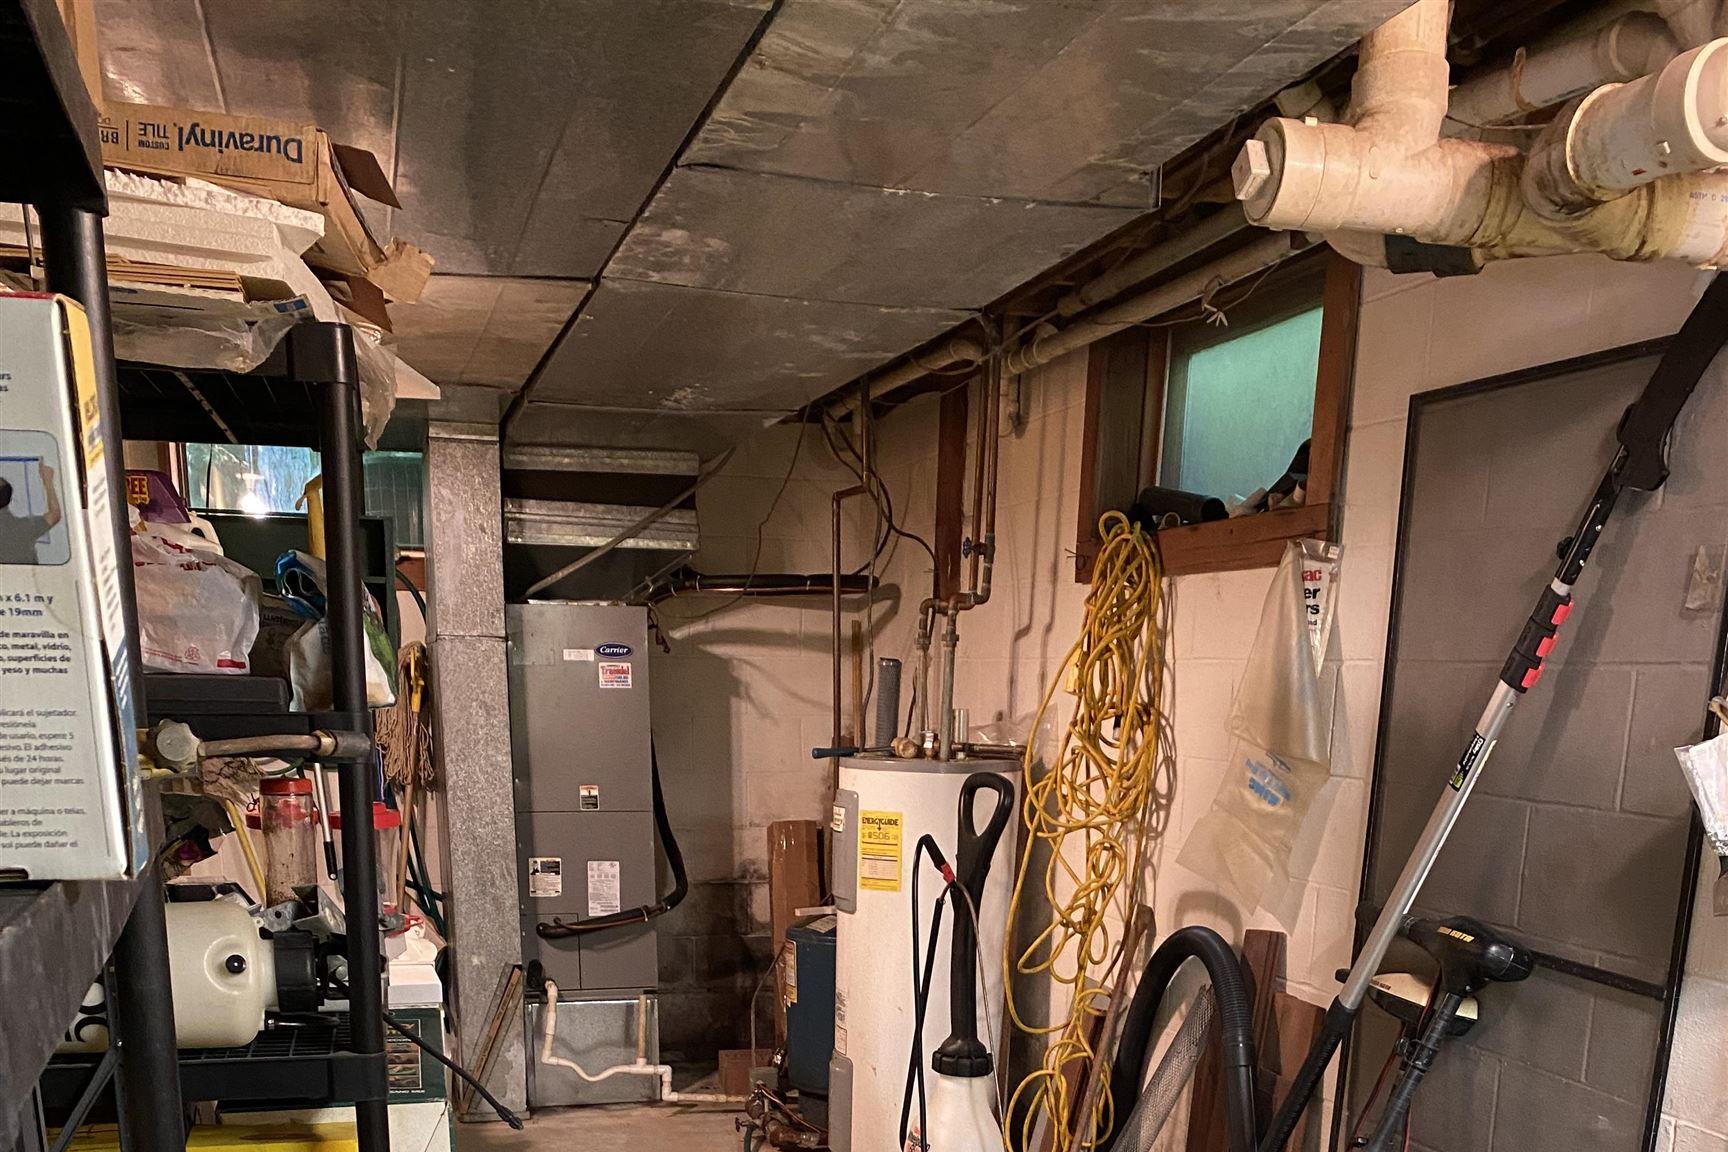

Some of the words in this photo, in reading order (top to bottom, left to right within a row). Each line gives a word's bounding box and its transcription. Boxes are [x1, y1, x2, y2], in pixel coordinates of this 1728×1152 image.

[138, 122, 169, 140] TILE
[138, 138, 169, 150] CUSTOM
[178, 122, 303, 163] Duravinyl
[14, 593, 31, 602] 6.1
[34, 594, 45, 602] m
[46, 595, 53, 604] y
[9, 607, 43, 616] 19mm
[12, 630, 55, 638] maravilla
[11, 642, 41, 651] metal,
[42, 642, 72, 651] vidrio,
[600, 645, 628, 653] Carrier
[7, 654, 57, 663] superficies
[59, 654, 71, 662] de
[2, 667, 23, 675] yeso
[33, 666, 68, 674] muchas
